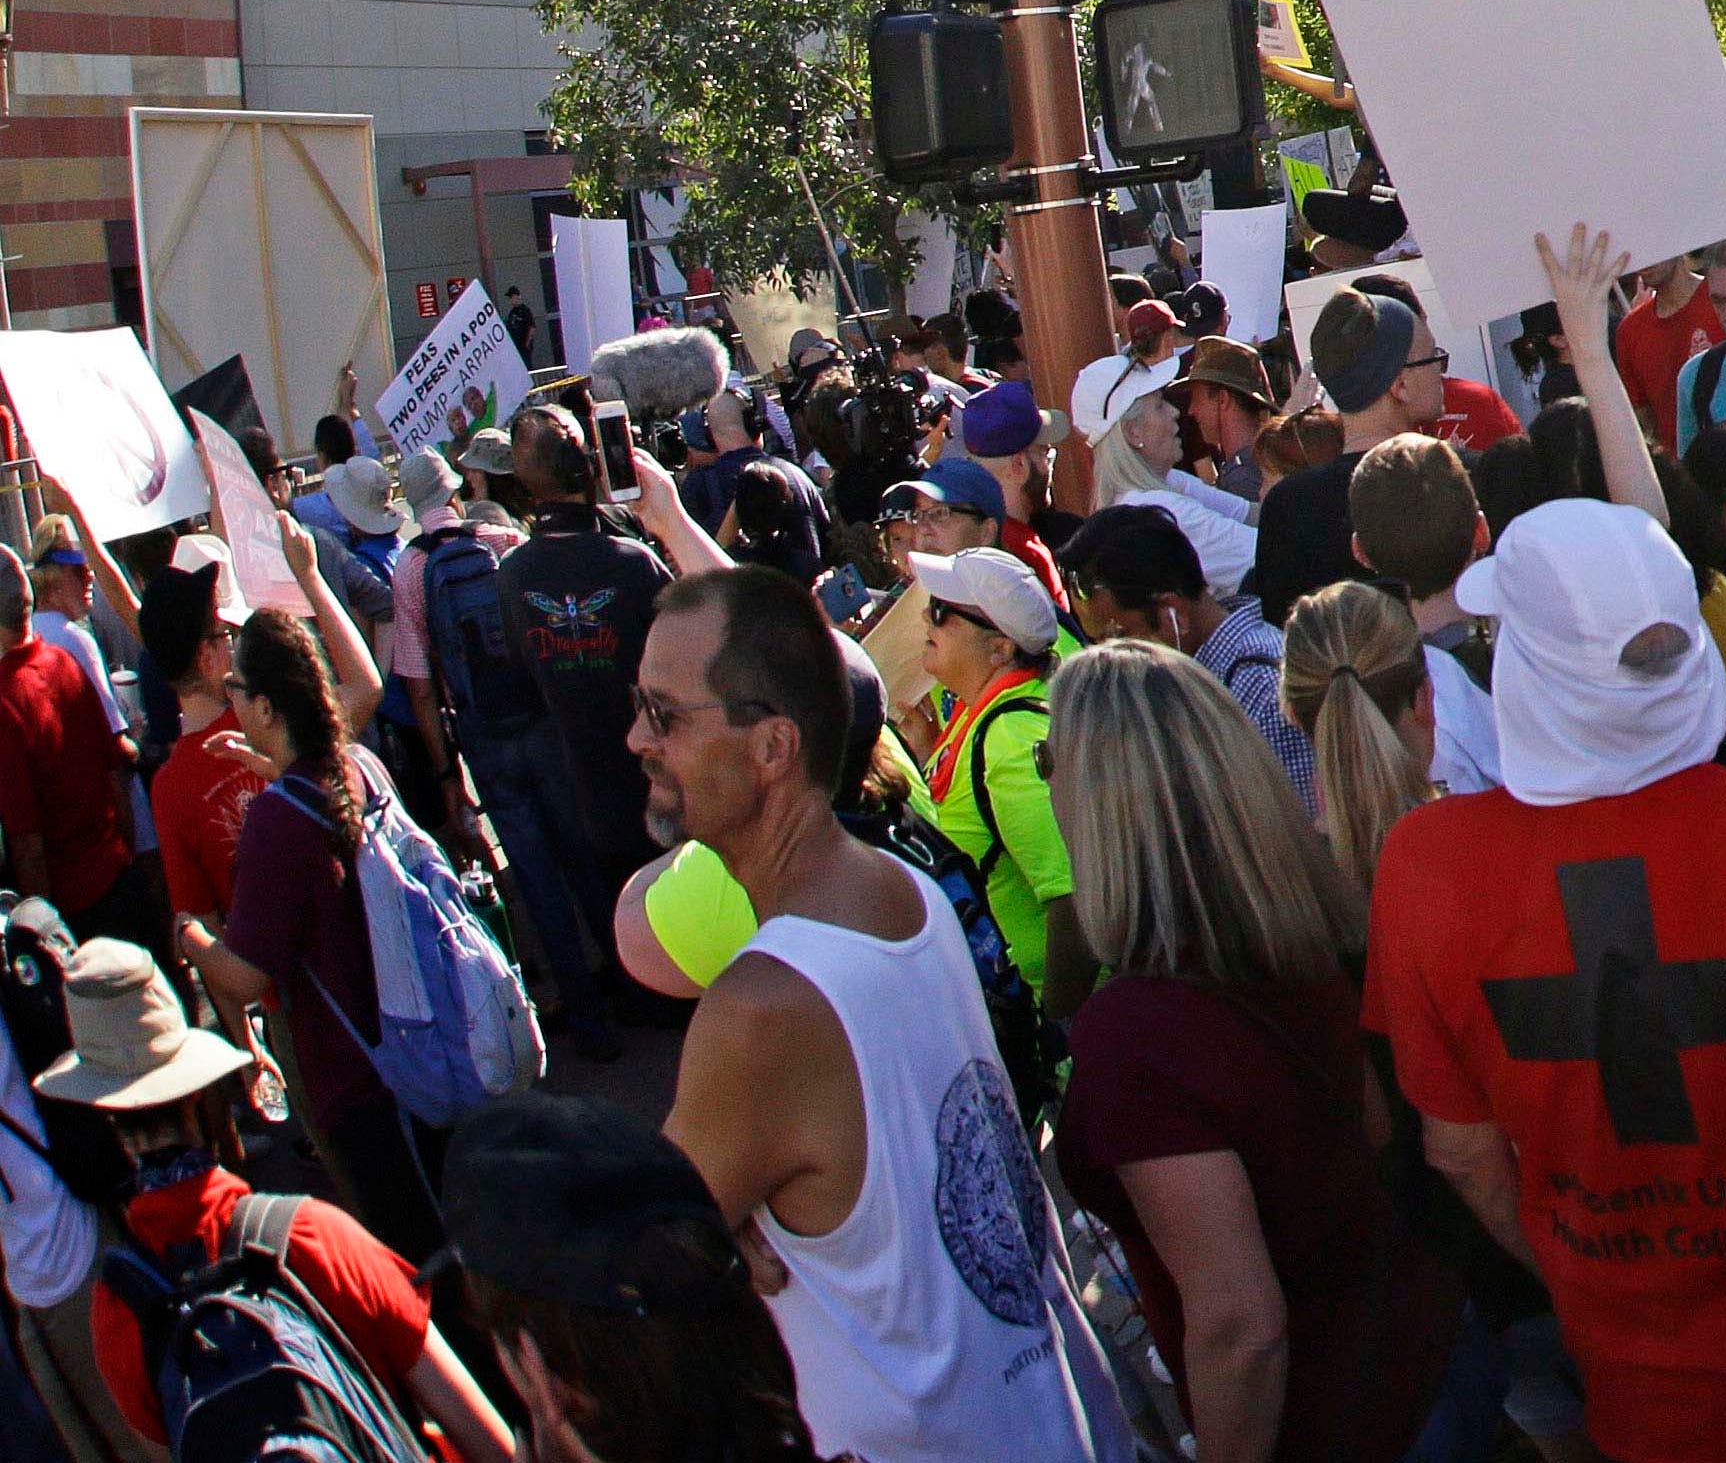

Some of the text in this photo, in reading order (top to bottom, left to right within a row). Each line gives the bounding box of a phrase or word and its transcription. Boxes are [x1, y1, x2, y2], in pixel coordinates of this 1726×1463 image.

[1191, 301, 1202, 318] S
[388, 396, 417, 433] TWO
[446, 344, 461, 366] IN
[462, 332, 471, 348] A
[469, 302, 494, 337] POD
[401, 394, 448, 454] TRUMP
[458, 323, 505, 388] ARPAIO
[405, 342, 438, 385] PEAS
